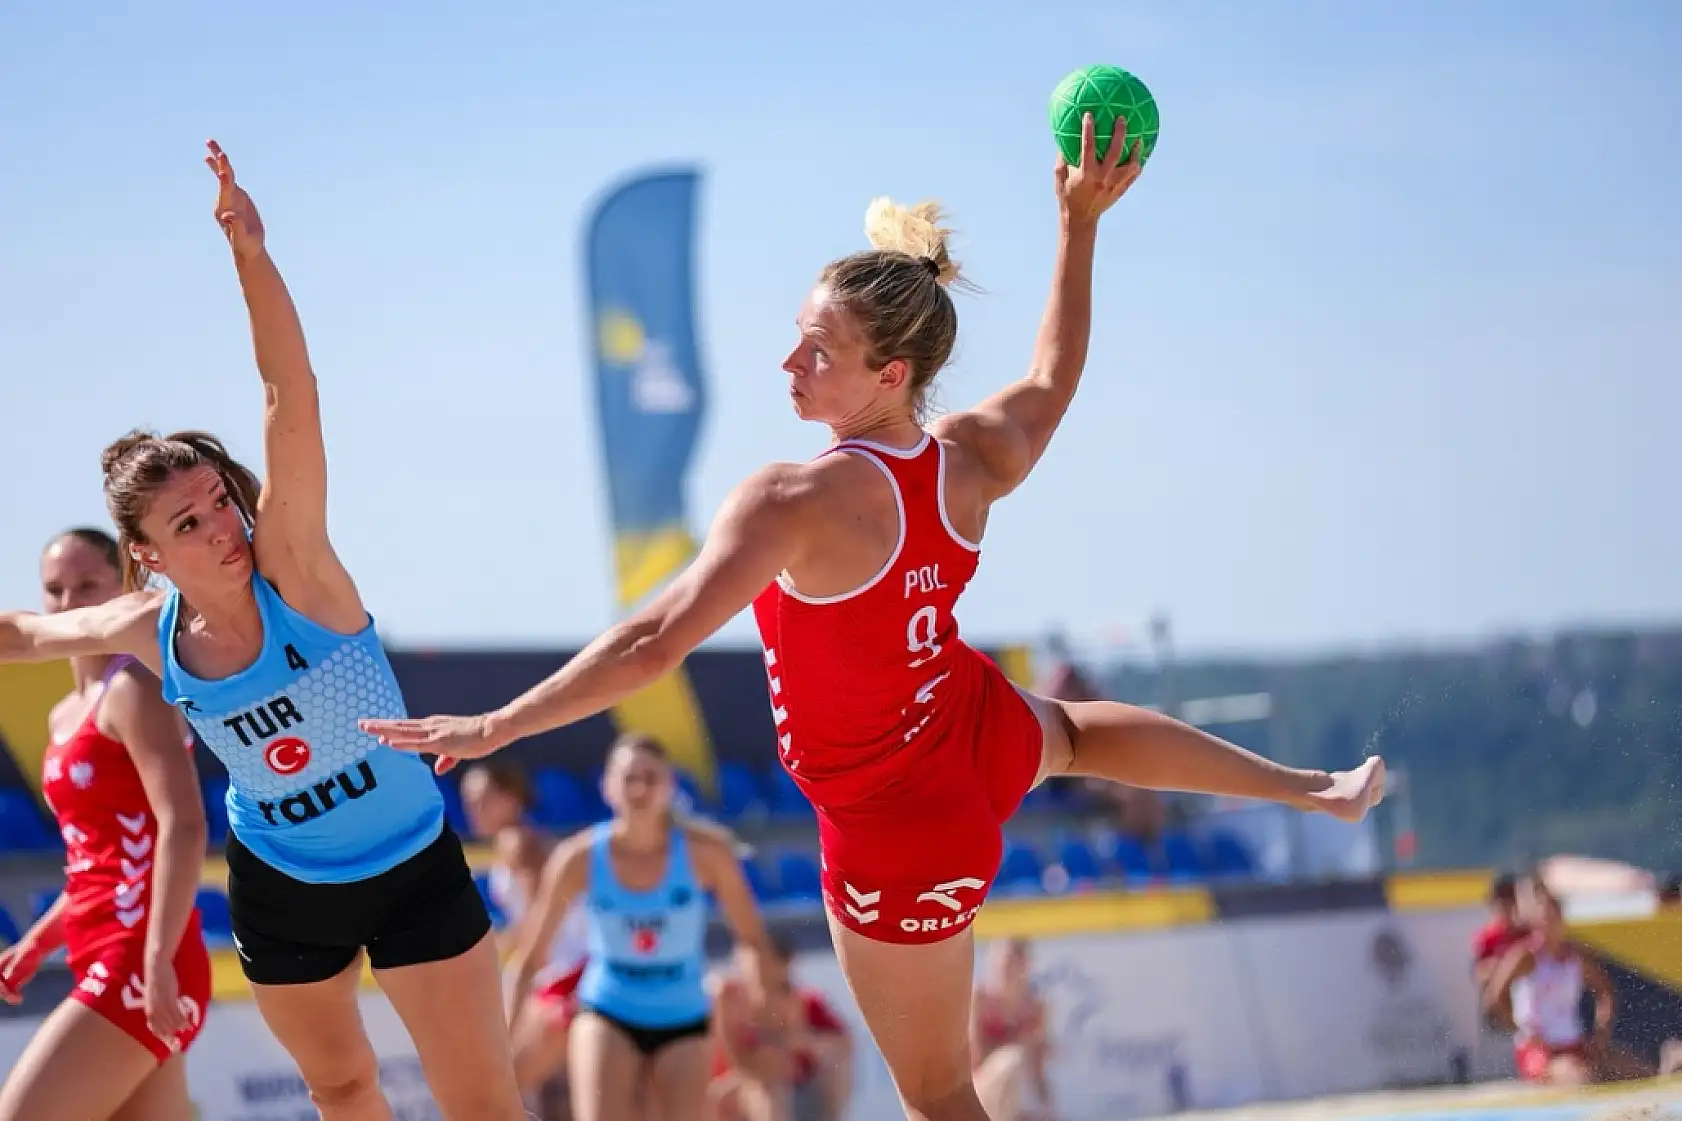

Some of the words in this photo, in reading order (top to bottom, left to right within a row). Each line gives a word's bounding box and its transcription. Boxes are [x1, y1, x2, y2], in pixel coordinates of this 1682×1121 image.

[904, 563, 948, 599] POL
[283, 643, 309, 671] 4
[907, 605, 942, 668] 9
[223, 696, 304, 746] TUR
